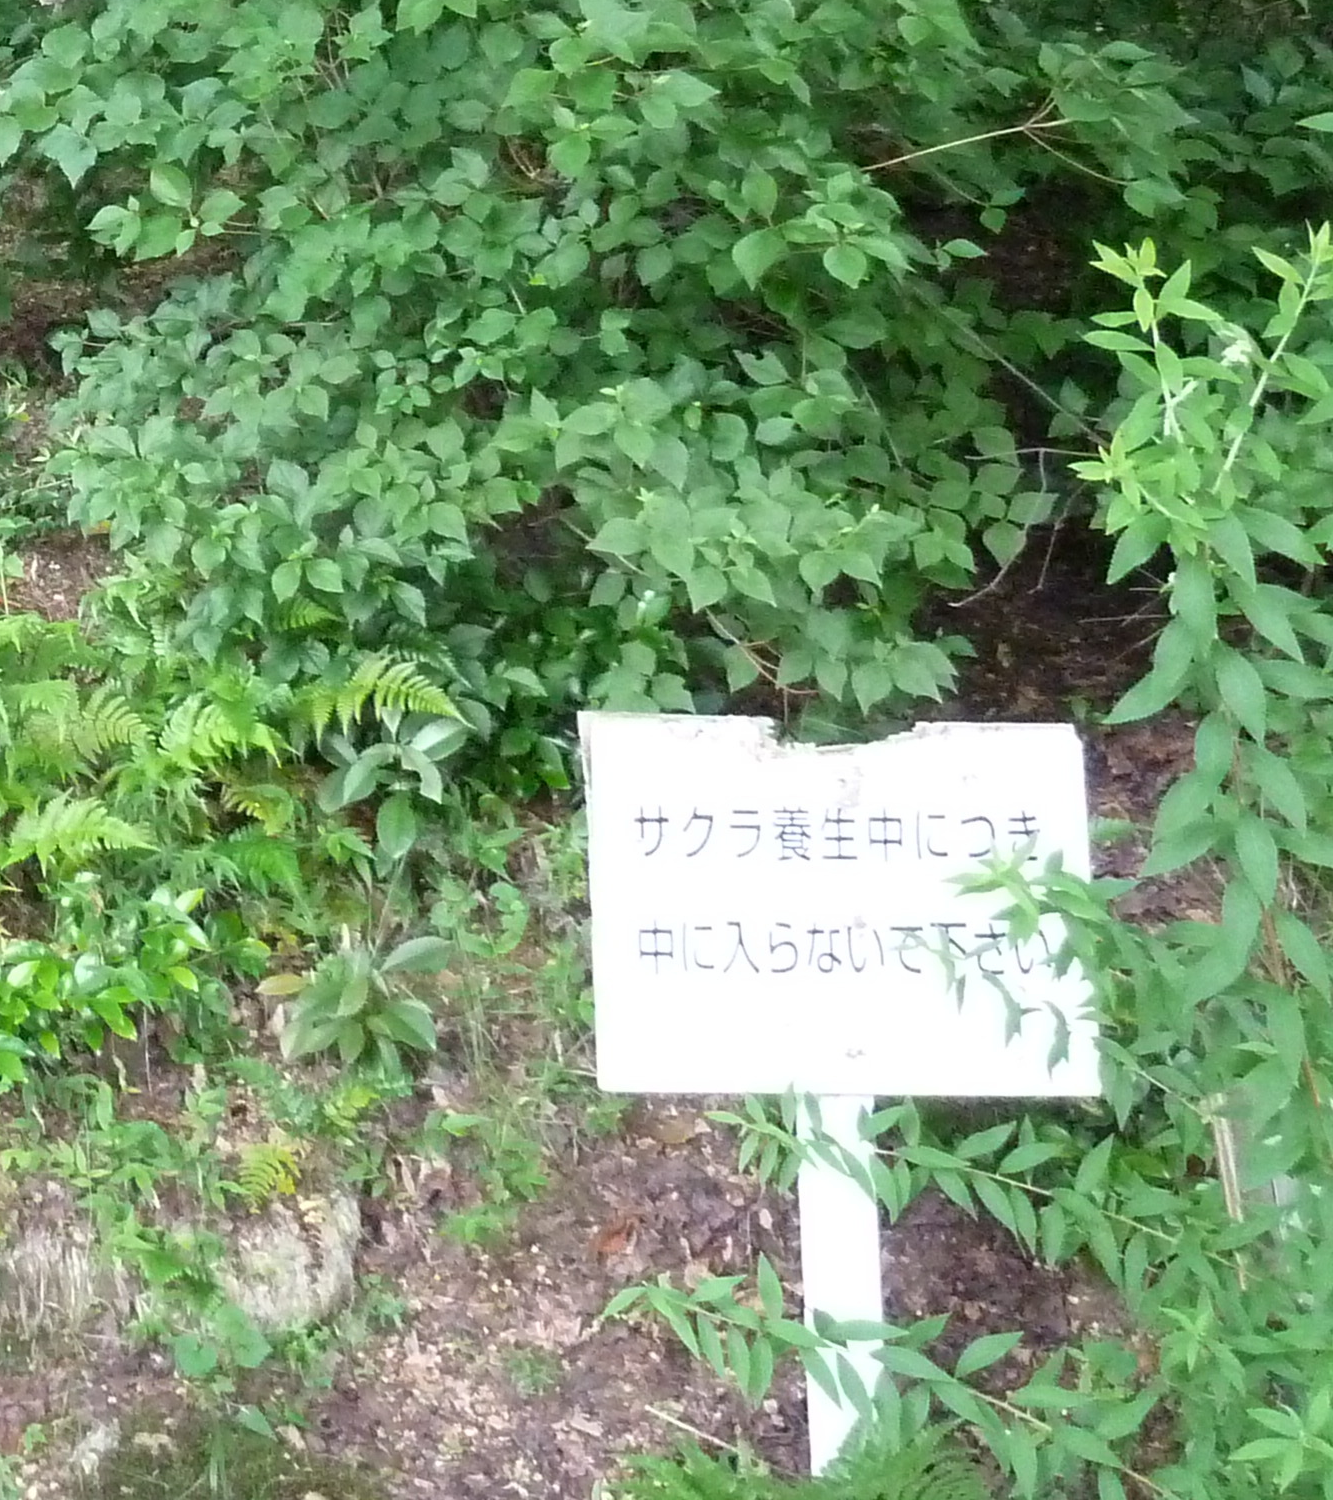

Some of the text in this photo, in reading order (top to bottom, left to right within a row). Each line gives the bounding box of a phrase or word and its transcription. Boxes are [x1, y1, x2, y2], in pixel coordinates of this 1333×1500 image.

[634, 805, 1040, 862] サクラ養生中につき
